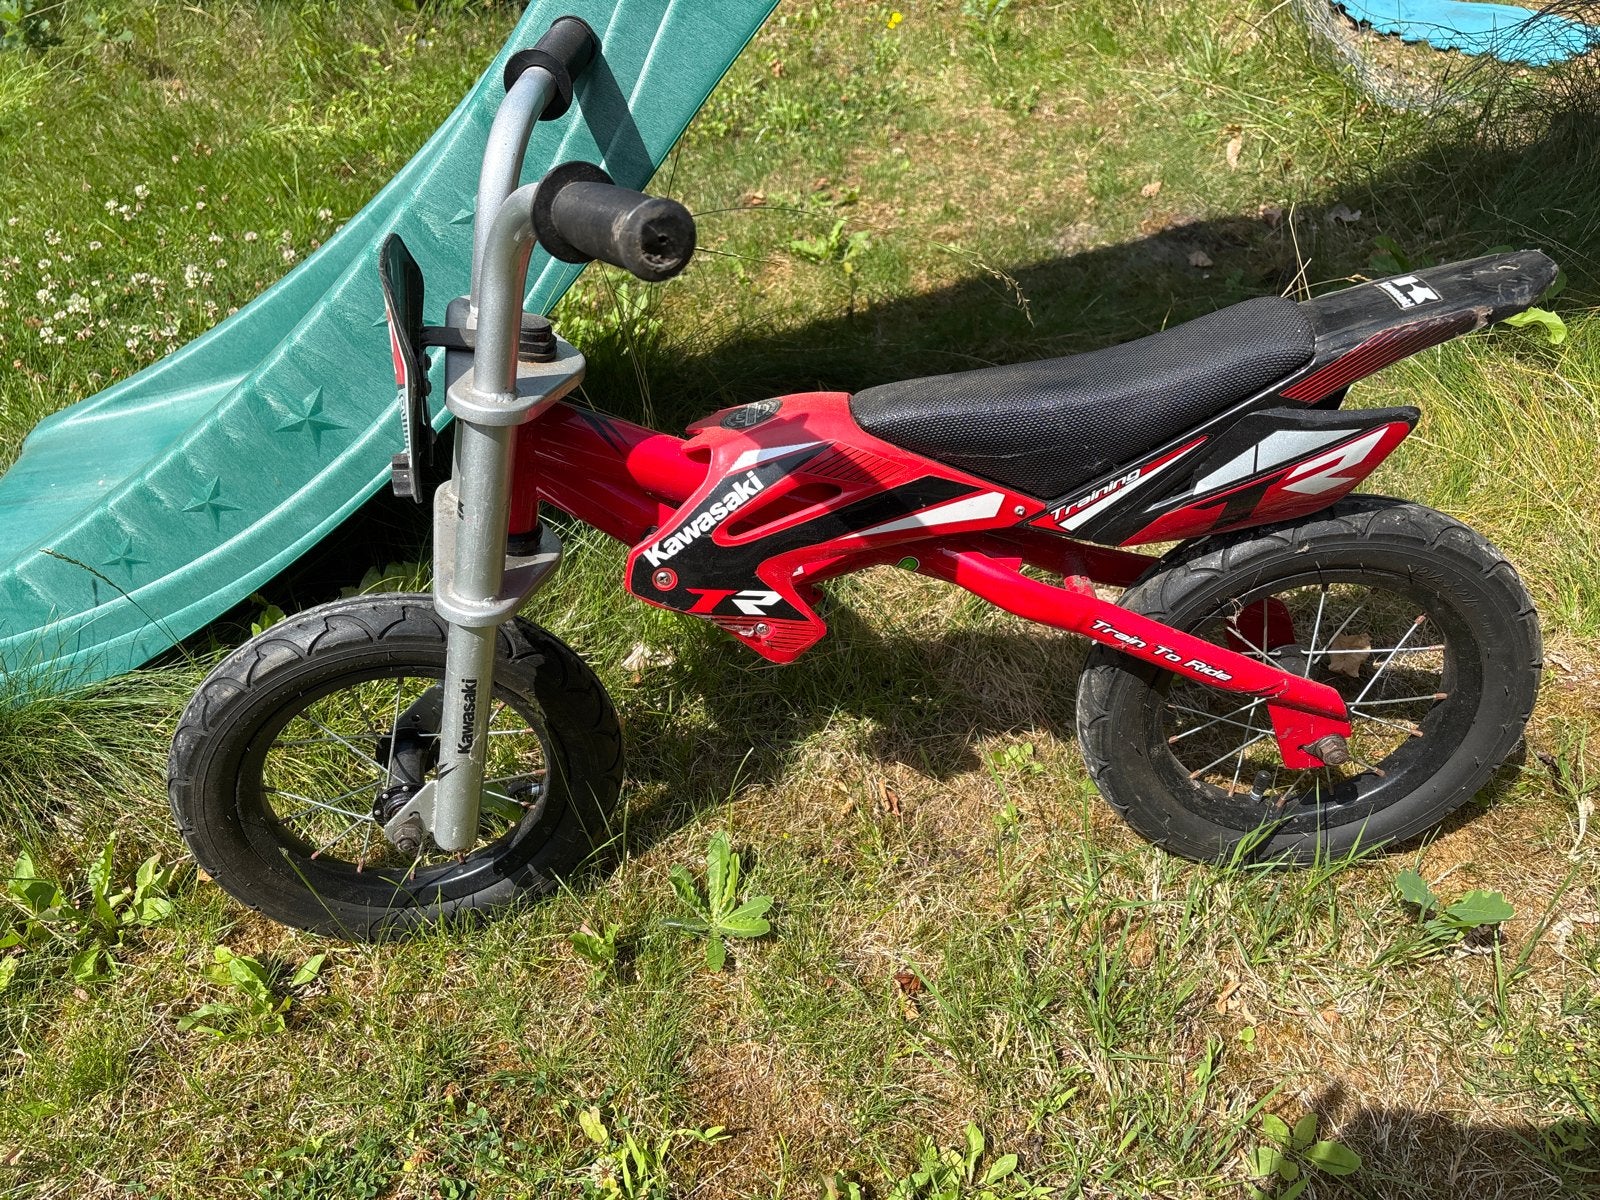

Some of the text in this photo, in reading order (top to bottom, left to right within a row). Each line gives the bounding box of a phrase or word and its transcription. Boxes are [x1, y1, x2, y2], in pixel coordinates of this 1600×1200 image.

[642, 471, 765, 567] Kawasaki
[1049, 467, 1142, 522] Training
[1091, 619, 1235, 683] Train To Ride
[457, 678, 478, 755] Kawasaki
